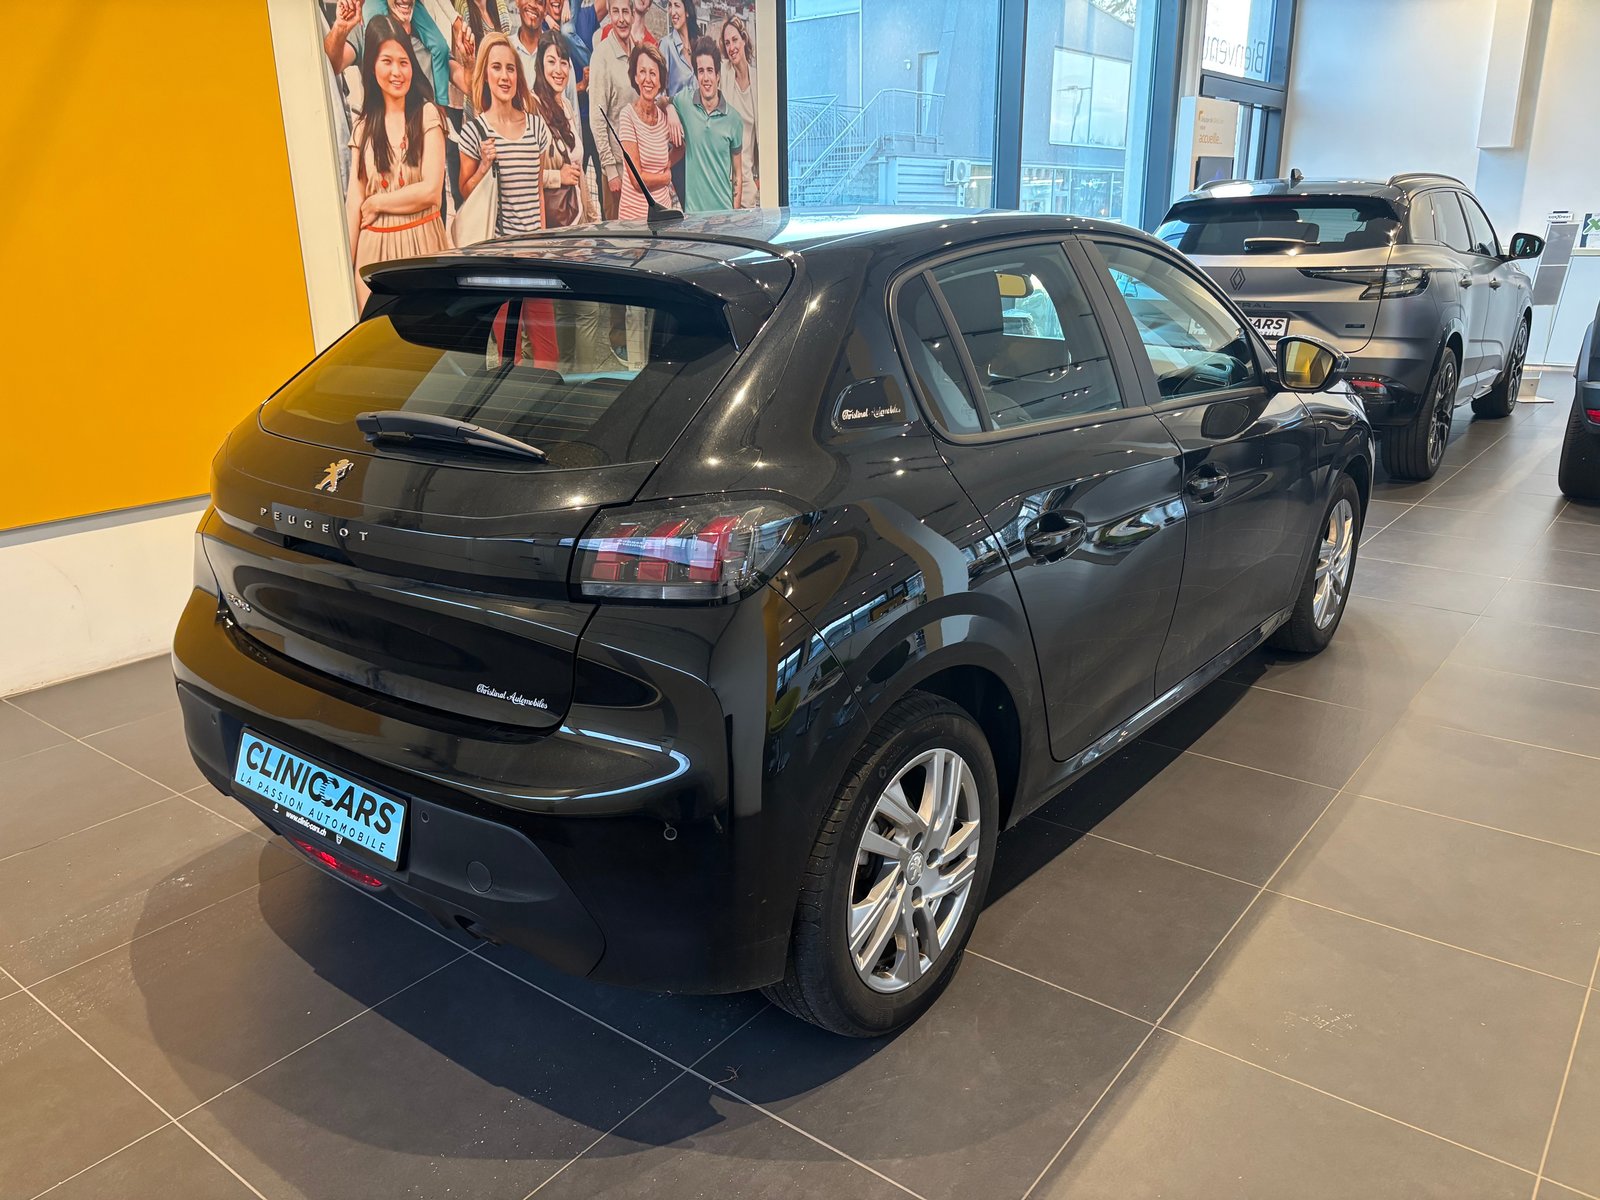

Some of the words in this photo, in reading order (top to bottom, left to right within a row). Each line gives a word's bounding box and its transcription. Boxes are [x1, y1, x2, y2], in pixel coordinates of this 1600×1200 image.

[1249, 318, 1284, 330] ARS
[260, 507, 369, 541] PEUGEOT
[240, 772, 252, 785] LA
[257, 781, 304, 813] PASSION
[308, 807, 386, 853] AUTOMOBILE
